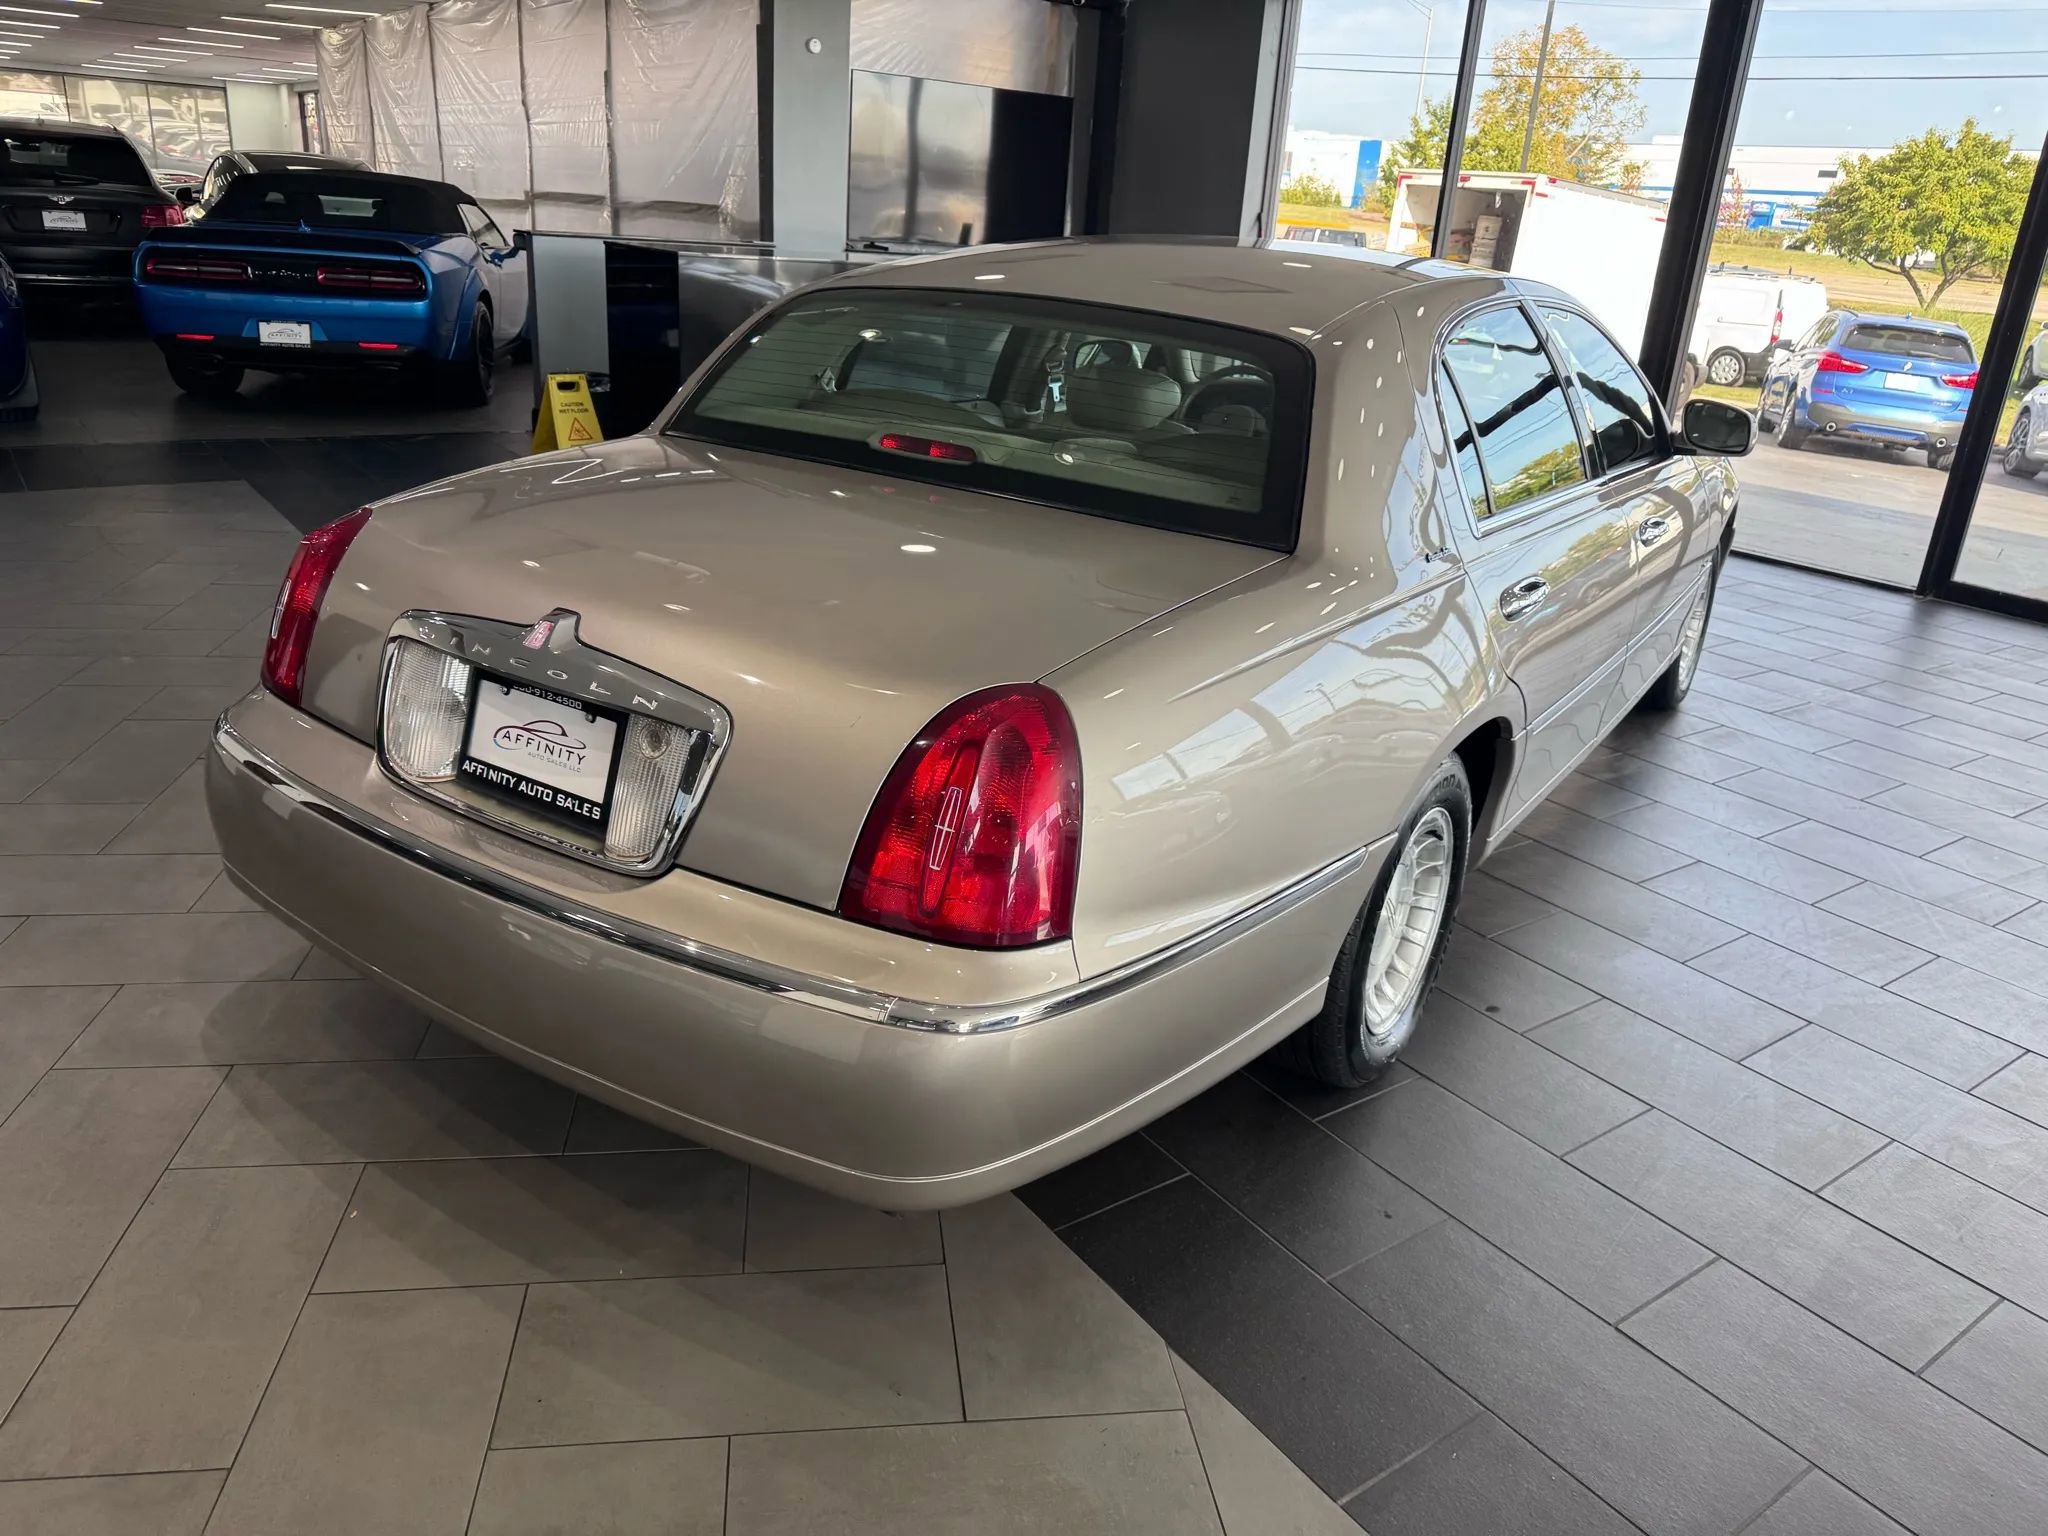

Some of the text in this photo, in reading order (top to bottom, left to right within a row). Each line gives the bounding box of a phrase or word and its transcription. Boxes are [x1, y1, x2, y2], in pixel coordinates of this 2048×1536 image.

[502, 730, 586, 765] AFFINITY
[528, 751, 582, 773] AUTO SALES LLC
[461, 760, 601, 820] AFFINITY AUTO SALES
